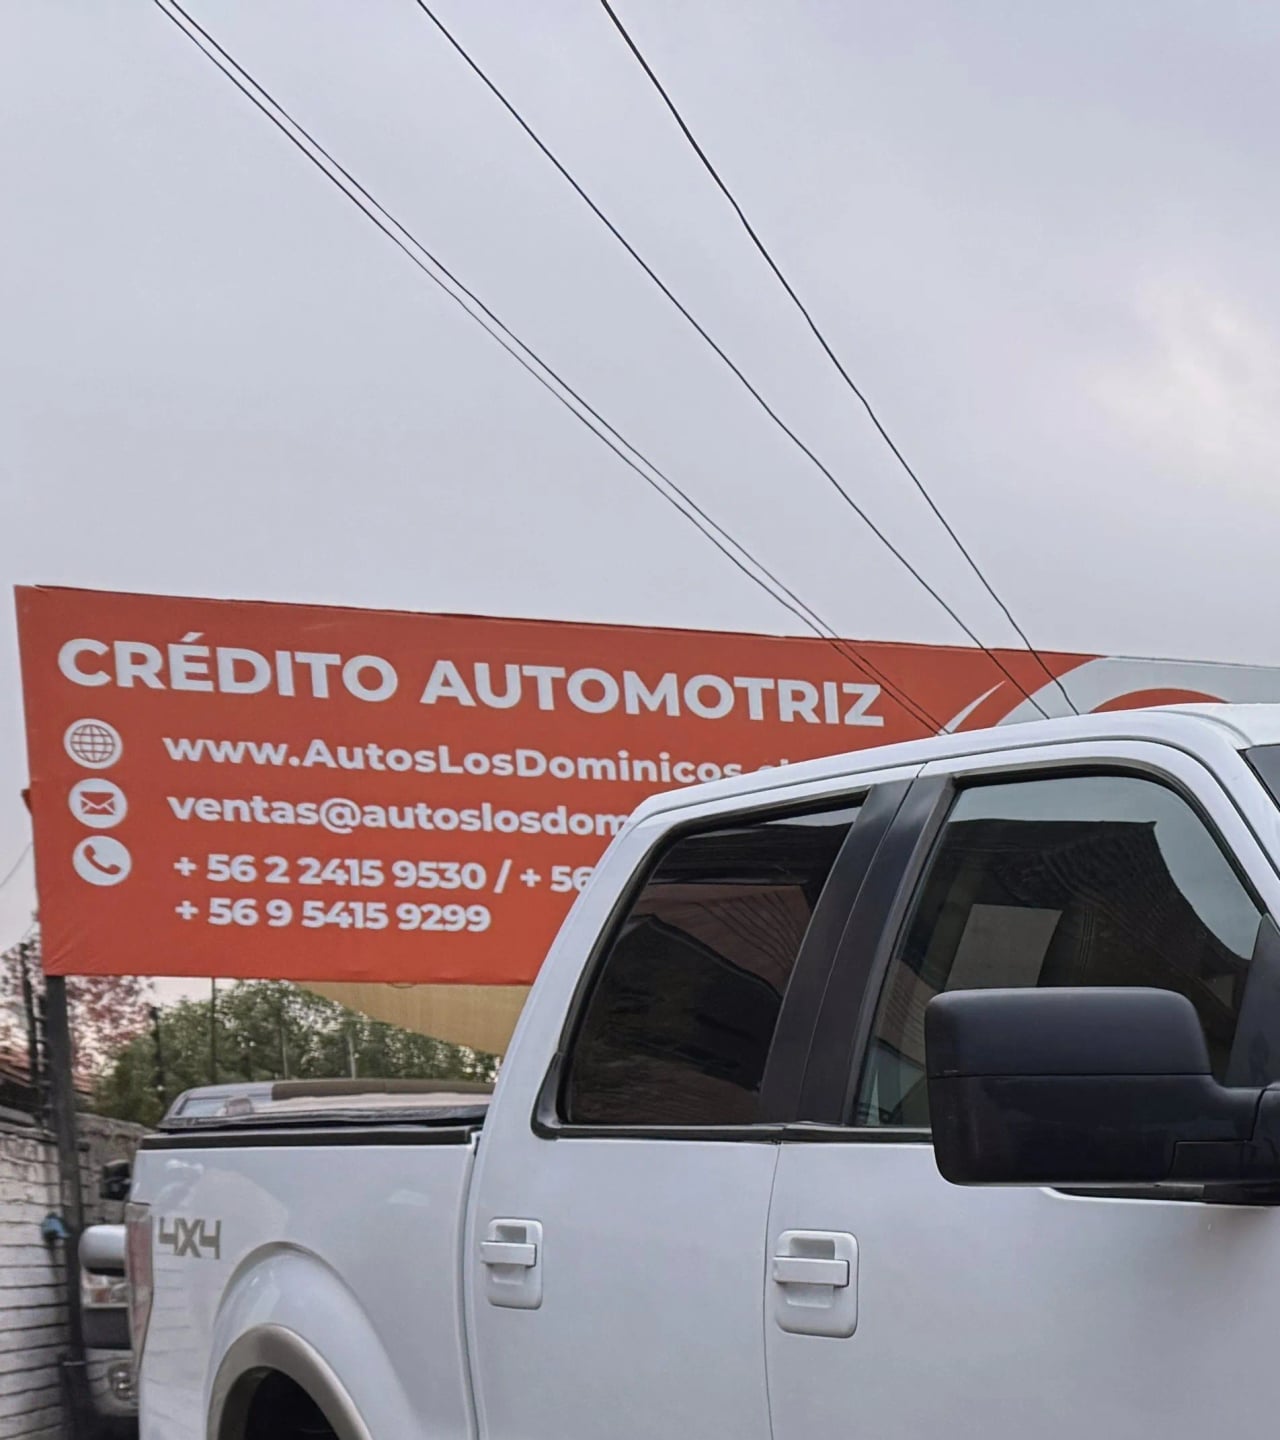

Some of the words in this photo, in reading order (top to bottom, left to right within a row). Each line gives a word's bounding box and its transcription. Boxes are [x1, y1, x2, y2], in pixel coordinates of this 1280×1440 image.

[57, 632, 398, 702] CRÉDITO
[420, 660, 884, 727] AUTOMOTRIZ
[162, 736, 789, 784] www.AutosLosDominicos
[207, 853, 256, 883] 56
[264, 856, 290, 884] 2
[298, 858, 384, 889] 2415
[392, 861, 486, 892] 9530
[550, 865, 597, 893] 56
[208, 898, 258, 926] 56
[266, 899, 292, 928] 9
[300, 901, 390, 931] 5415
[397, 902, 491, 933] 9299
